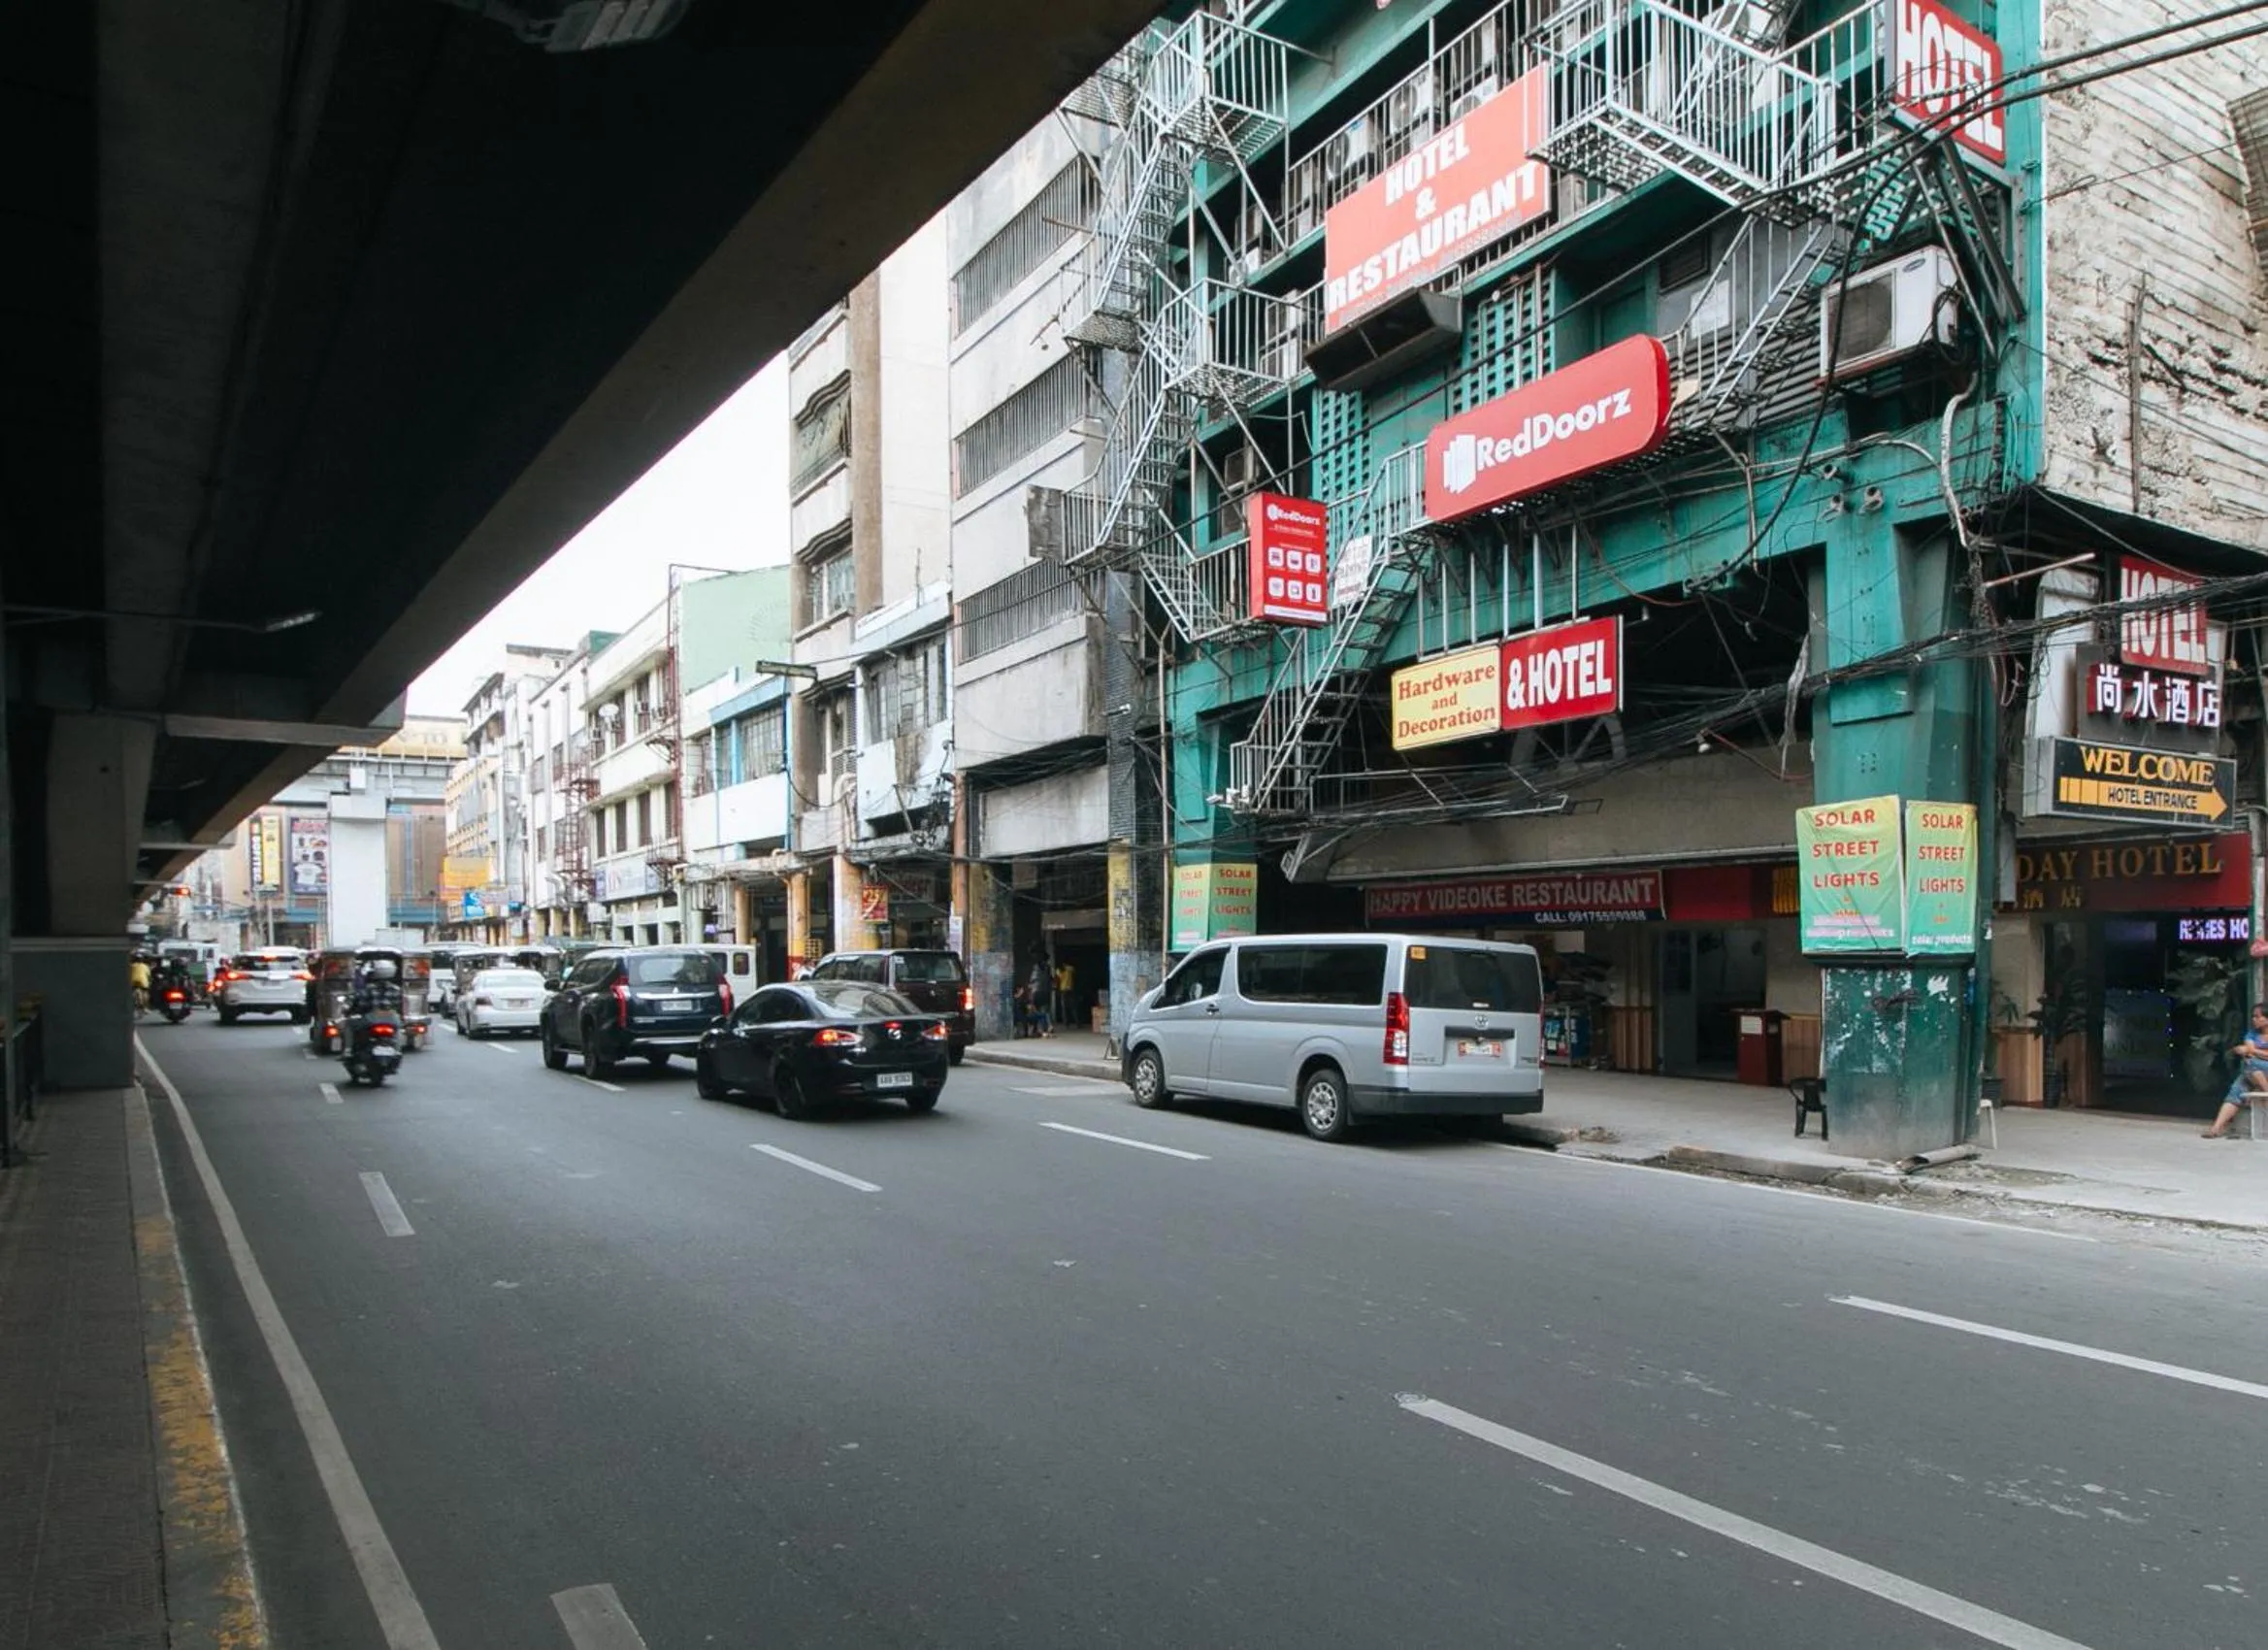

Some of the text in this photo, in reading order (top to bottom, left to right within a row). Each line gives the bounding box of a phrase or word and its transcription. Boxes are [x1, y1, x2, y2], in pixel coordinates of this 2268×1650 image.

[1896, 0, 2003, 152] HOTEL
[1385, 123, 1470, 206] HOTEL
[1415, 187, 1437, 219] &
[1328, 164, 1538, 314] RESTAURANT
[1476, 388, 1632, 471] RedDoorz
[2121, 567, 2206, 664] HOTEL
[1398, 664, 1496, 701] Hardware
[2096, 663, 2220, 728] 尚水酒店
[1431, 692, 1459, 710] and
[1397, 707, 1496, 738] Decoration
[2080, 745, 2216, 786] WELCOME
[2108, 787, 2197, 809] HOTEL ENTRANCE
[1815, 808, 1876, 827] SOLAR
[1923, 813, 1963, 829] SOLAR
[1812, 841, 1879, 858] STREET
[1918, 845, 1964, 861] STREET
[2090, 842, 2223, 879] HOTEL
[1369, 877, 1656, 913] HAPPY VIDEOKE RESTAURANT
[1814, 872, 1880, 888] LIGHTS
[1919, 877, 1964, 893] LIGHTS
[1534, 910, 1566, 923] CALL:
